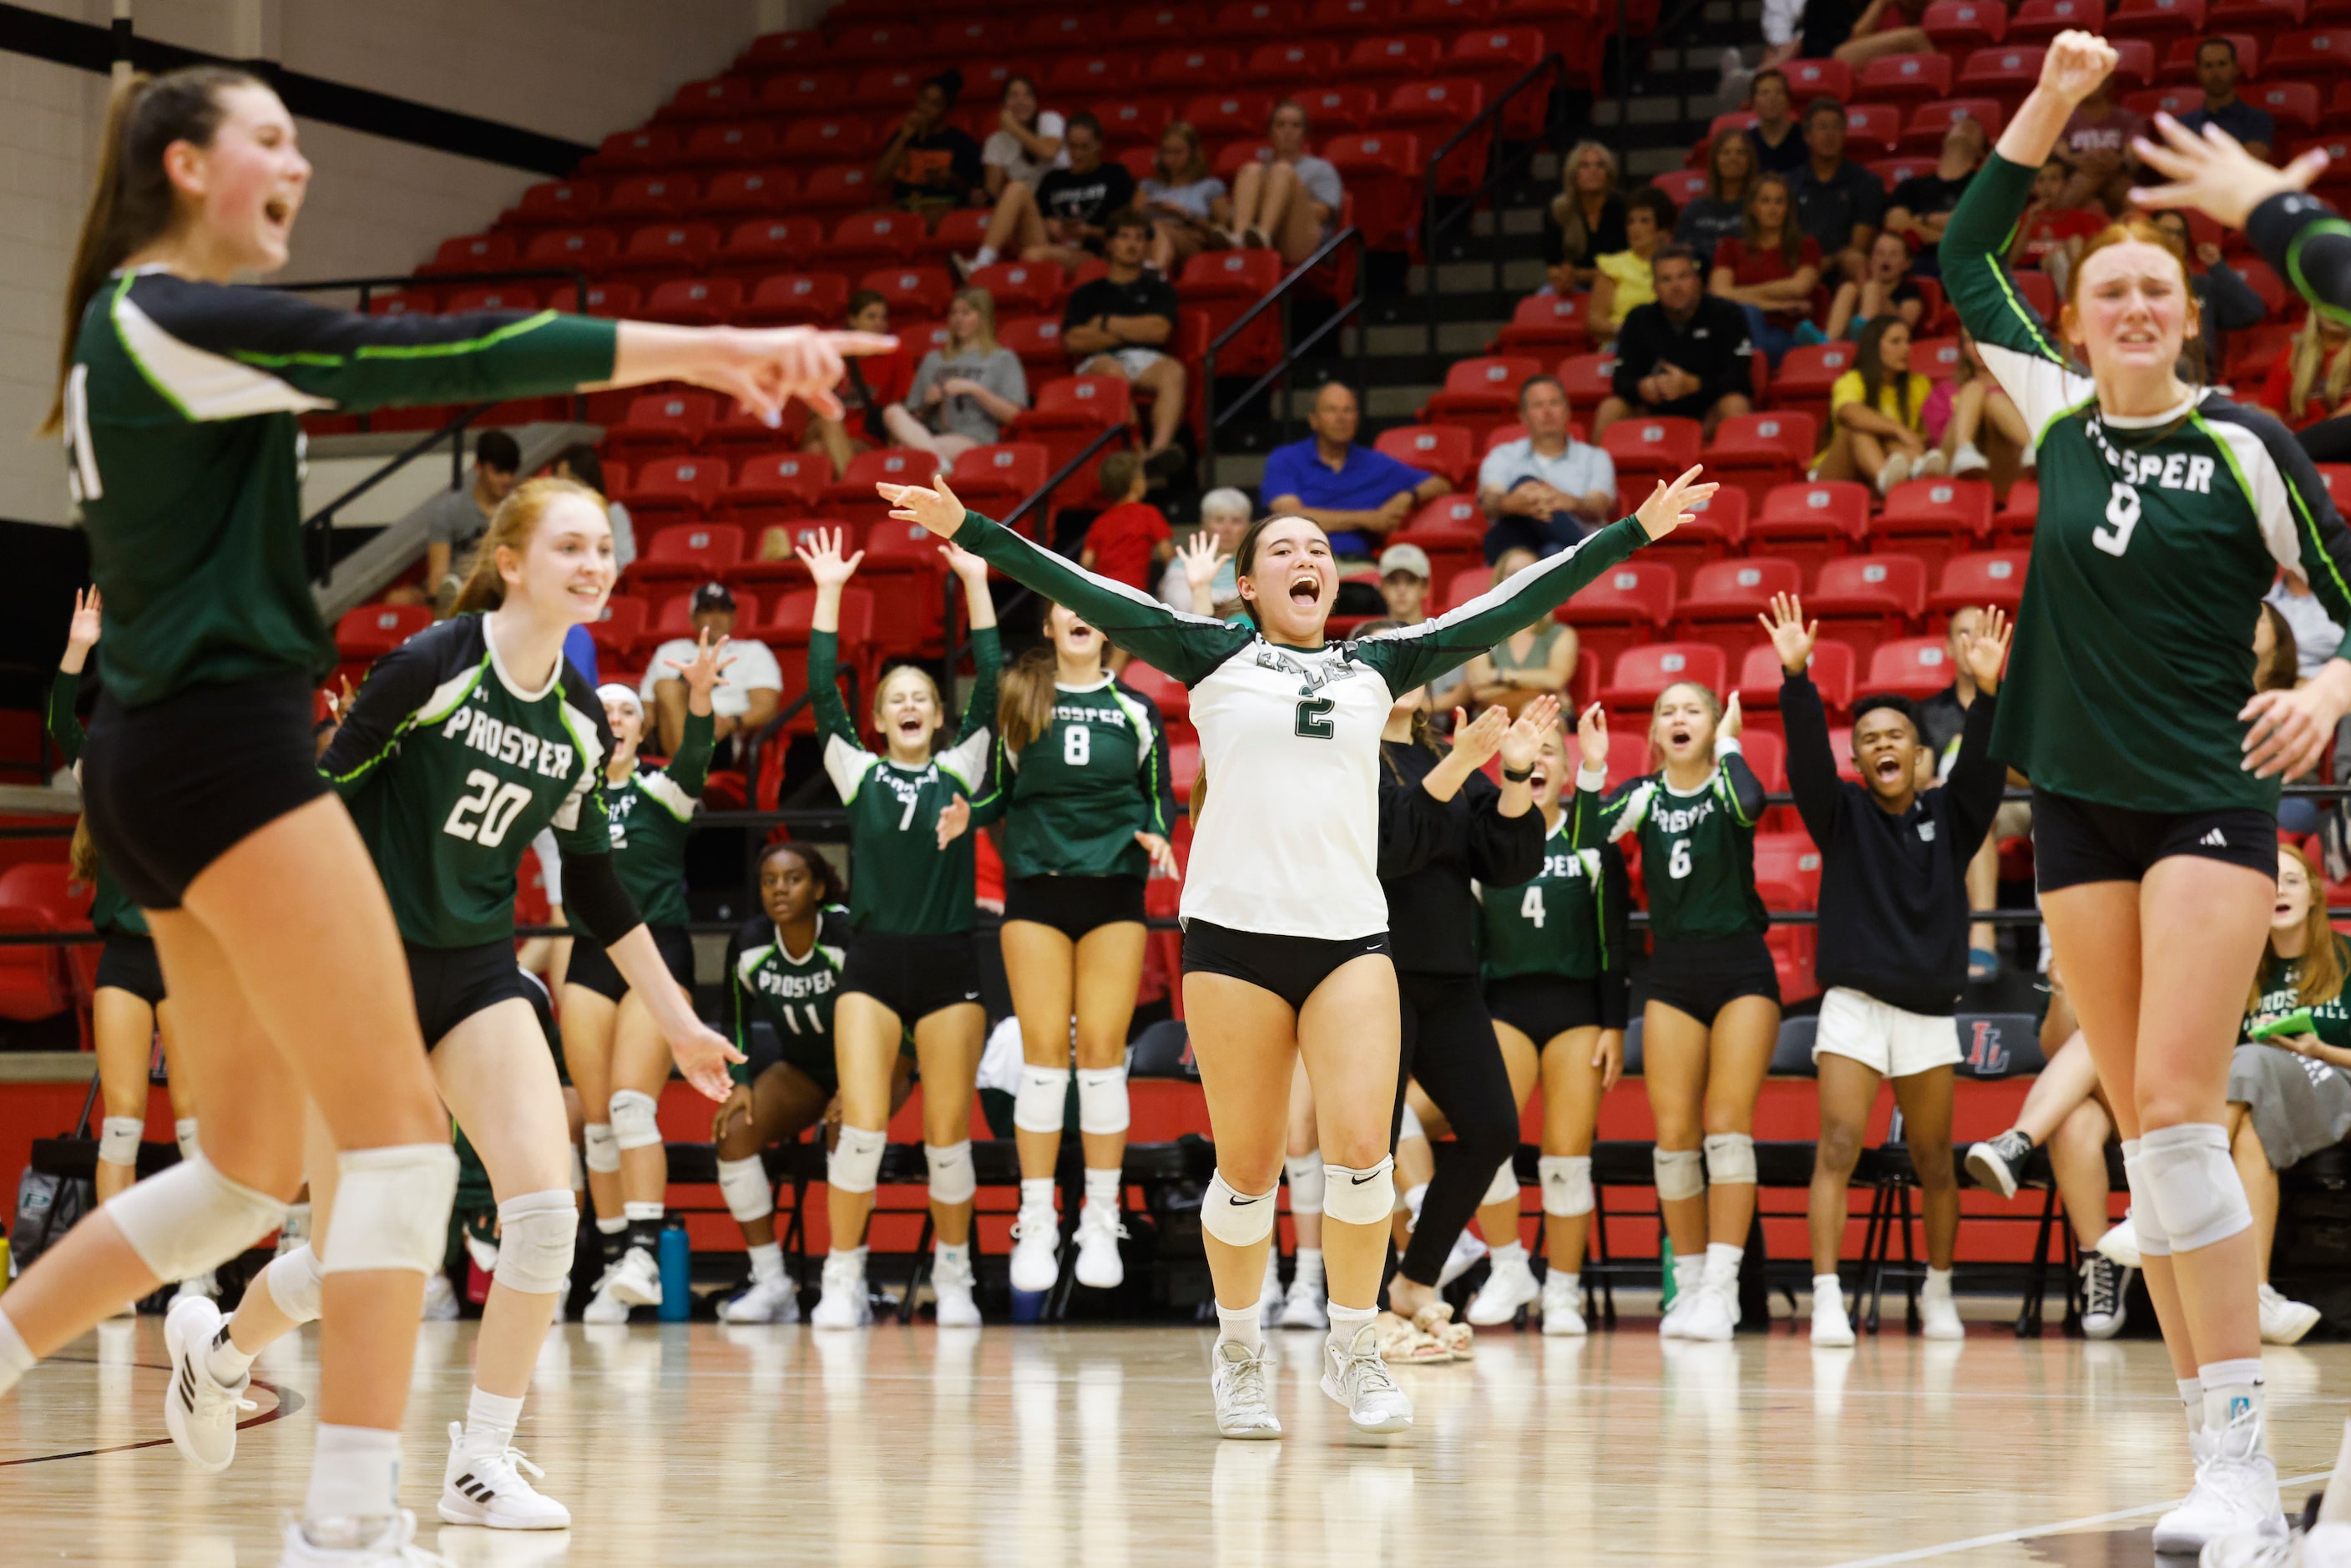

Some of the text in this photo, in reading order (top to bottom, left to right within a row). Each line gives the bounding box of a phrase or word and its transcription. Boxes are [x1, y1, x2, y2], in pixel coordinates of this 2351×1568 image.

[2085, 416, 2215, 494] SPER
[2092, 482, 2141, 558] 9
[1052, 706, 1126, 728] OSPER
[1295, 685, 1336, 740] 2
[441, 706, 574, 780] PROSPER
[1064, 724, 1090, 766] 8
[442, 768, 533, 848] 20
[897, 792, 918, 831] 7
[1668, 837, 1692, 879] 6
[1520, 885, 1546, 928] 4
[782, 1003, 826, 1034] 11
